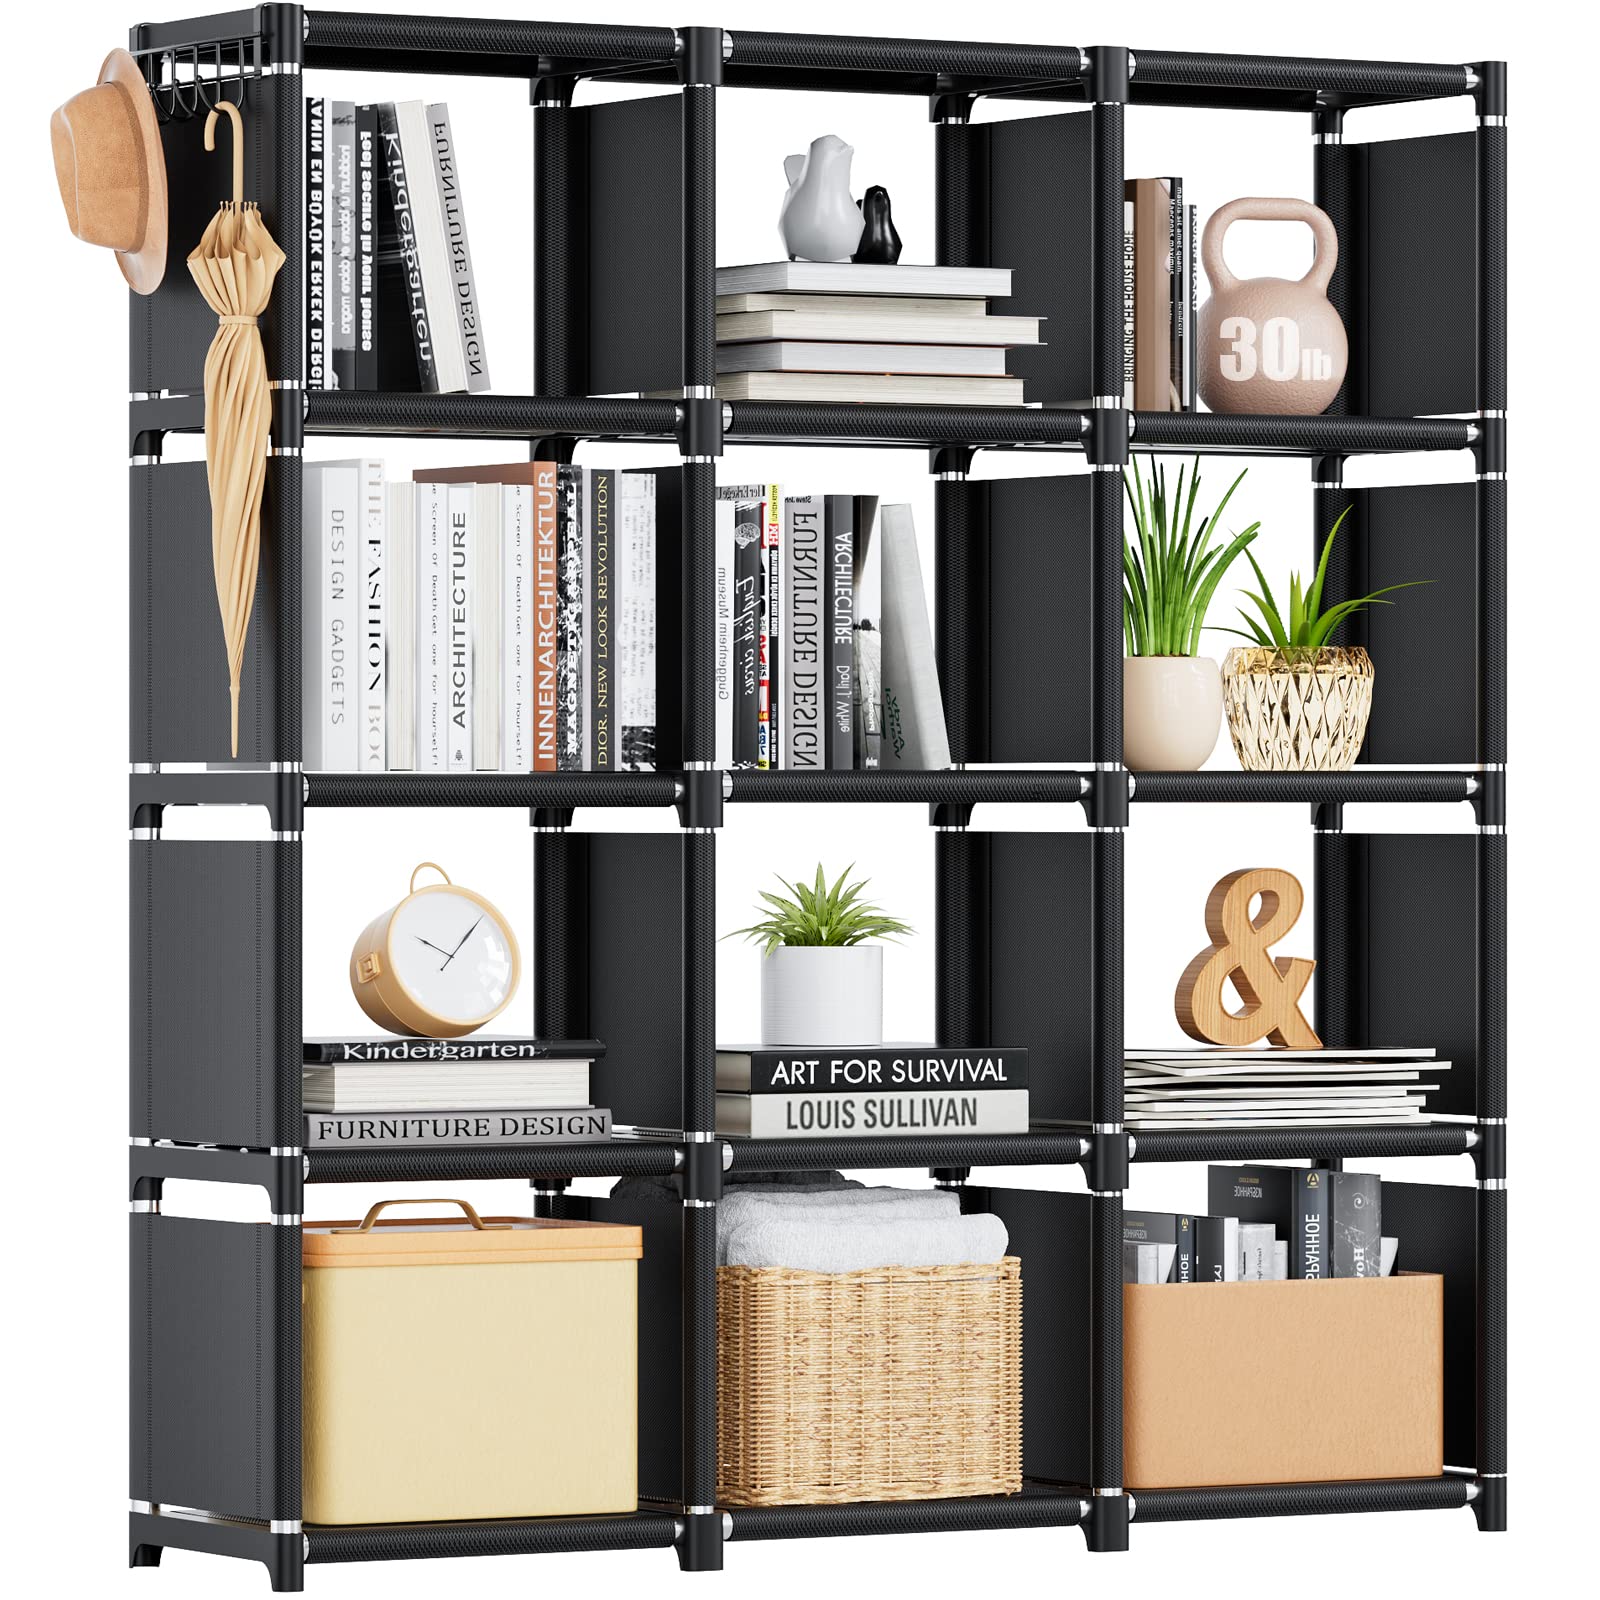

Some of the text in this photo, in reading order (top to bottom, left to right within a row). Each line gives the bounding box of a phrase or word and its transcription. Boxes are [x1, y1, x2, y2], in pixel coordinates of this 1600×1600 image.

[1124, 265, 1134, 300] HOUSE
[1124, 304, 1134, 324] THE
[1124, 329, 1134, 382] BRINGING
[432, 553, 438, 566] Of
[516, 554, 522, 568] Of
[331, 510, 344, 725] DESIGN GADGETS
[368, 540, 382, 690] FASHION
[452, 512, 466, 729] ARCHITECTURE
[538, 472, 554, 759] INNENARCHITEKTUR
[598, 475, 608, 766] DIOR. NEW LOOK REVOLUTION
[344, 1041, 535, 1060] Kindergarten
[771, 1058, 1008, 1086] ART FOR SURVIVAL
[318, 1116, 606, 1140] FURNITURE DESIGN
[786, 1097, 977, 1130] LOUIS SULLIVAN
